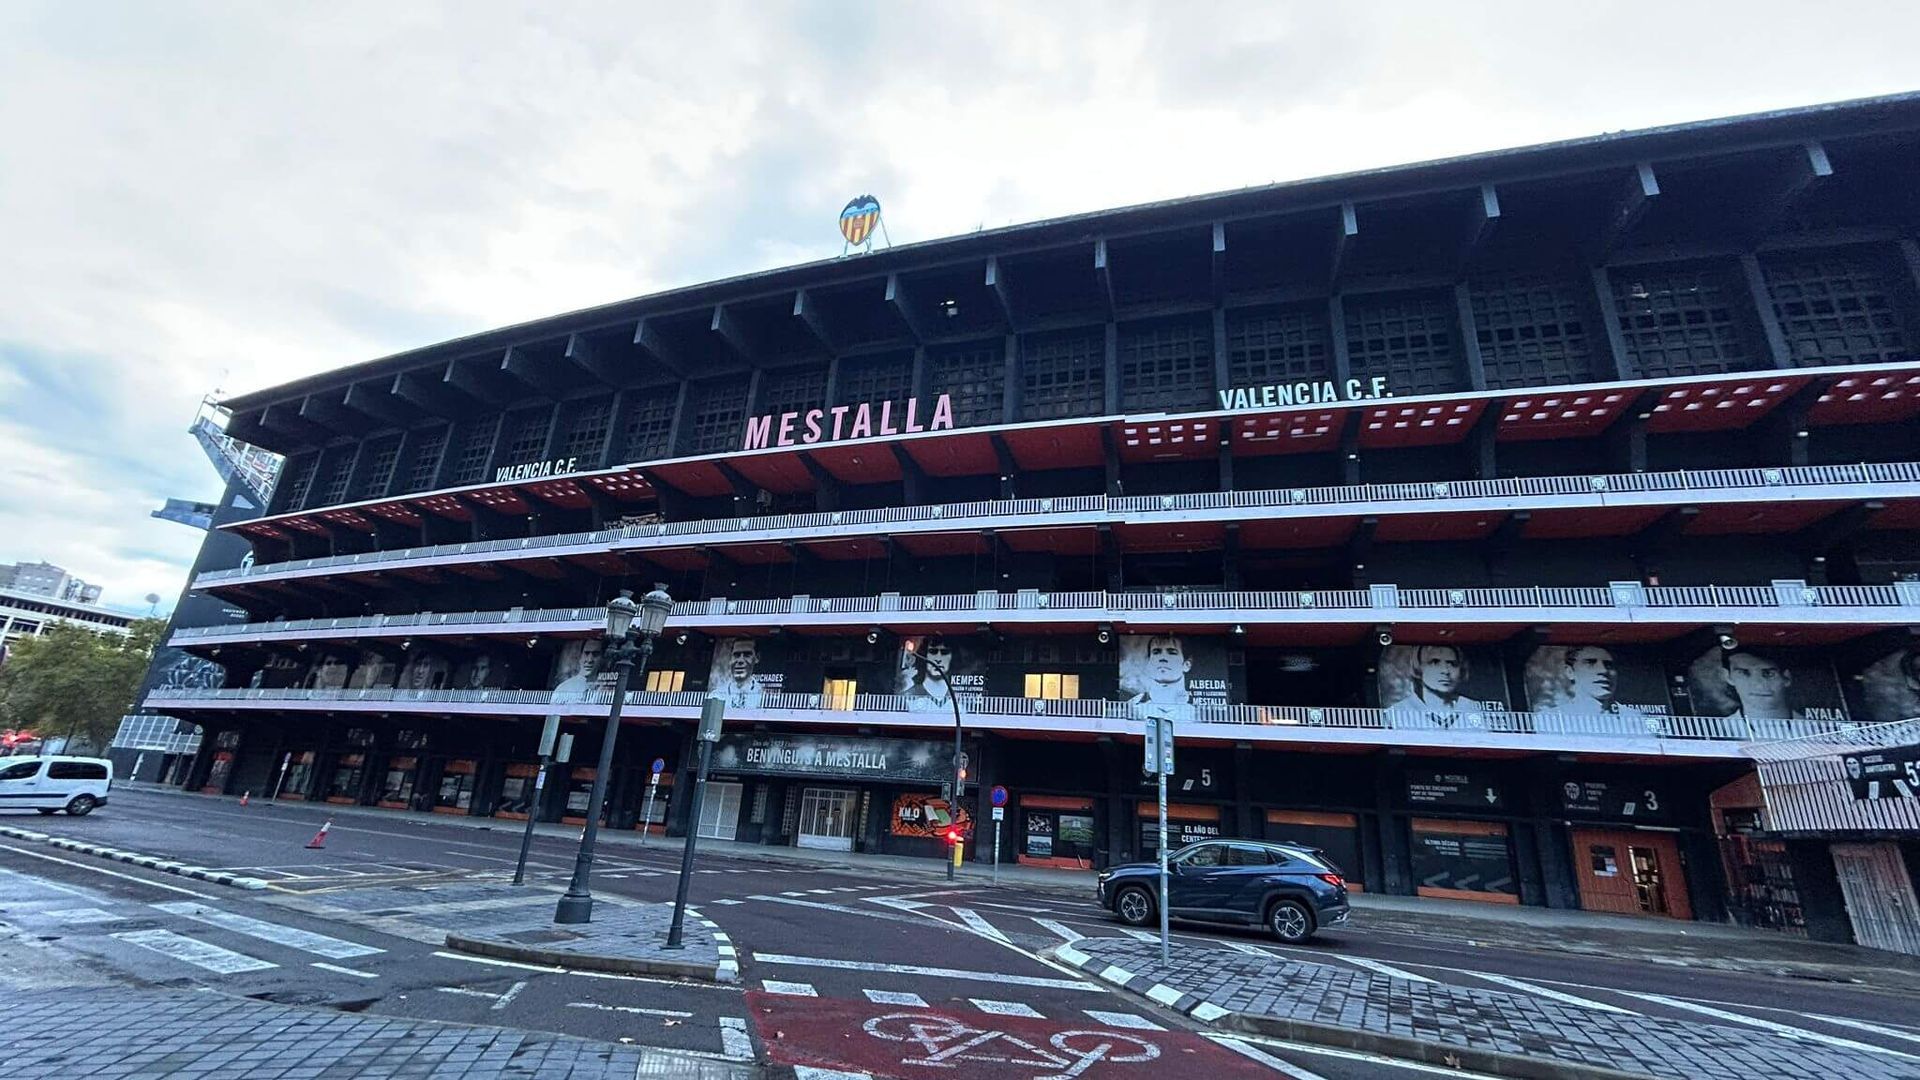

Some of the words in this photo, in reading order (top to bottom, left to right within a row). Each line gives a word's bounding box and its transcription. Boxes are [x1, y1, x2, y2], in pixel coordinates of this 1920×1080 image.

[1220, 381, 1337, 410] VALENCIA
[1346, 376, 1393, 400] C.F.
[744, 394, 953, 450] MESTALLA
[496, 461, 551, 482] VALENCIA
[554, 458, 577, 475] C.F.
[951, 675, 984, 686] KEMPES
[1190, 680, 1226, 690] ALBELDA
[1193, 698, 1227, 706] MESTALLA
[1805, 707, 1844, 720] AYALA
[747, 747, 812, 765] BENVINGUTS
[814, 751, 822, 766] A
[826, 751, 887, 770] MESTALLA
[1202, 769, 1211, 786] 5
[1644, 790, 1659, 810] 3
[1193, 825, 1206, 834] AÑO
[1207, 826, 1219, 835] DEL
